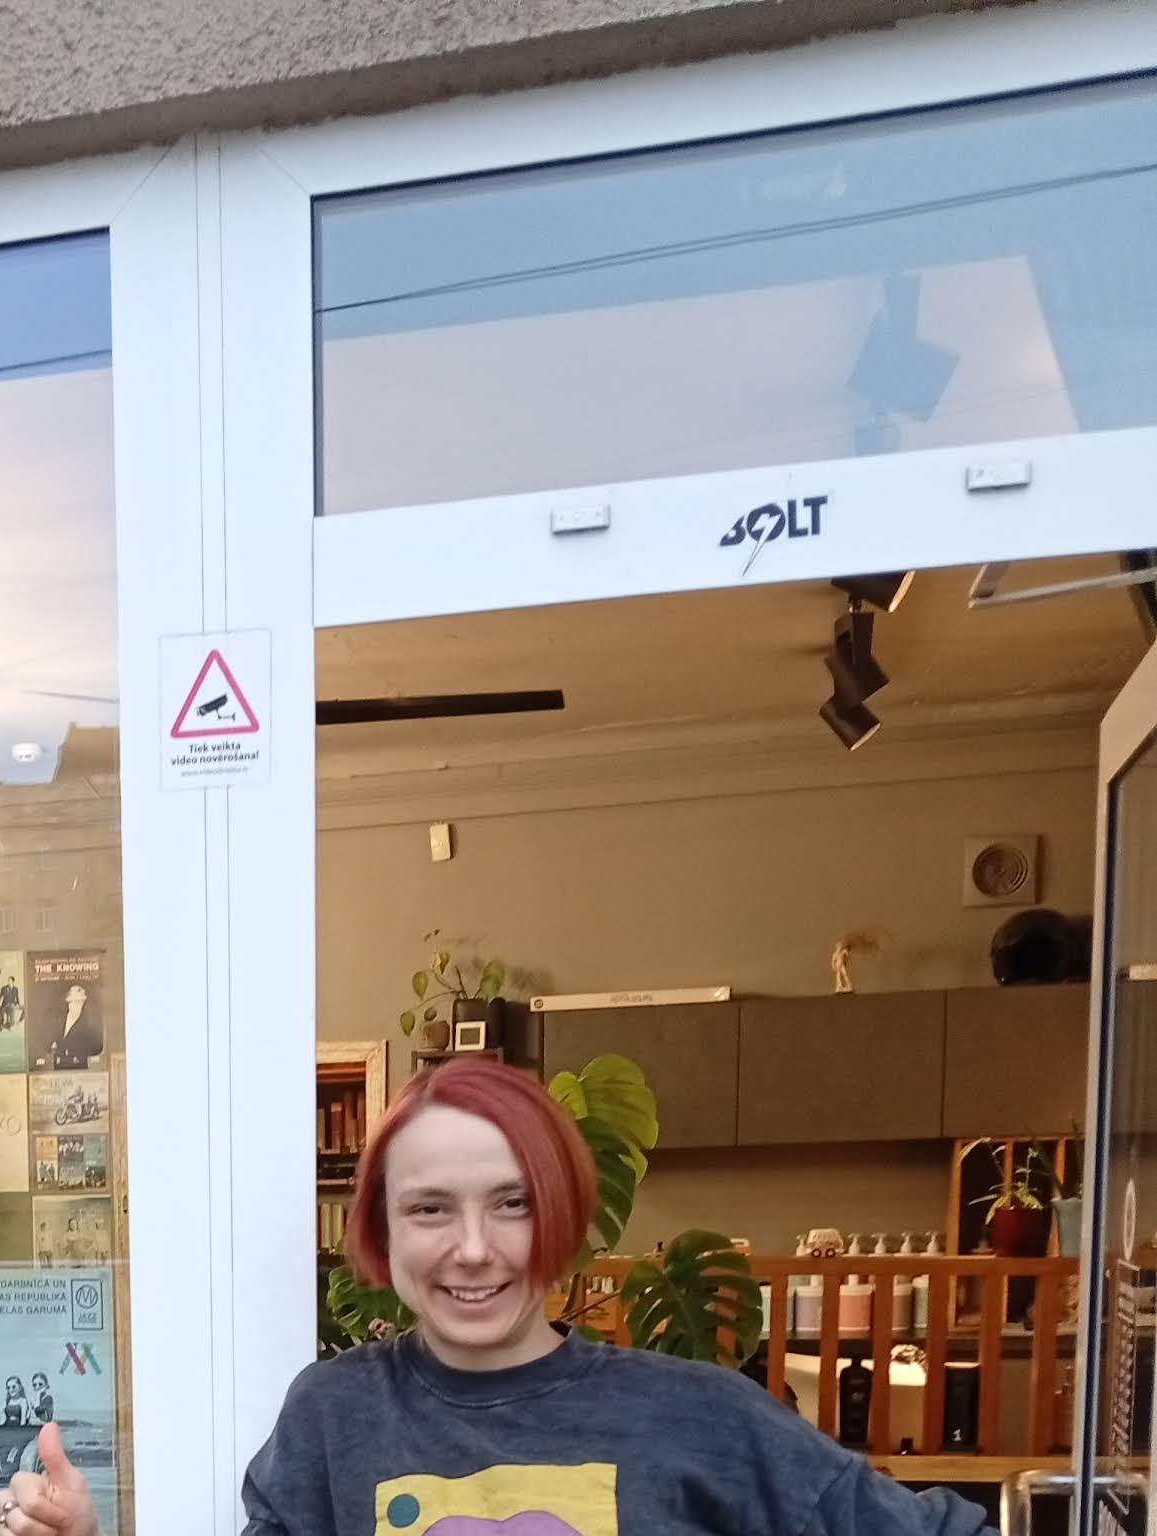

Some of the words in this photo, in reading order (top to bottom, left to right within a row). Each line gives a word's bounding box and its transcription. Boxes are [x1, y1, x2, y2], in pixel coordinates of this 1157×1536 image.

[719, 495, 828, 548] BOLT
[189, 743, 209, 753] Tiek
[211, 741, 241, 752] veikta
[172, 755, 198, 766] video
[35, 964, 52, 973] THE
[57, 962, 99, 973] KNOWING
[53, 1279, 67, 1288] UN
